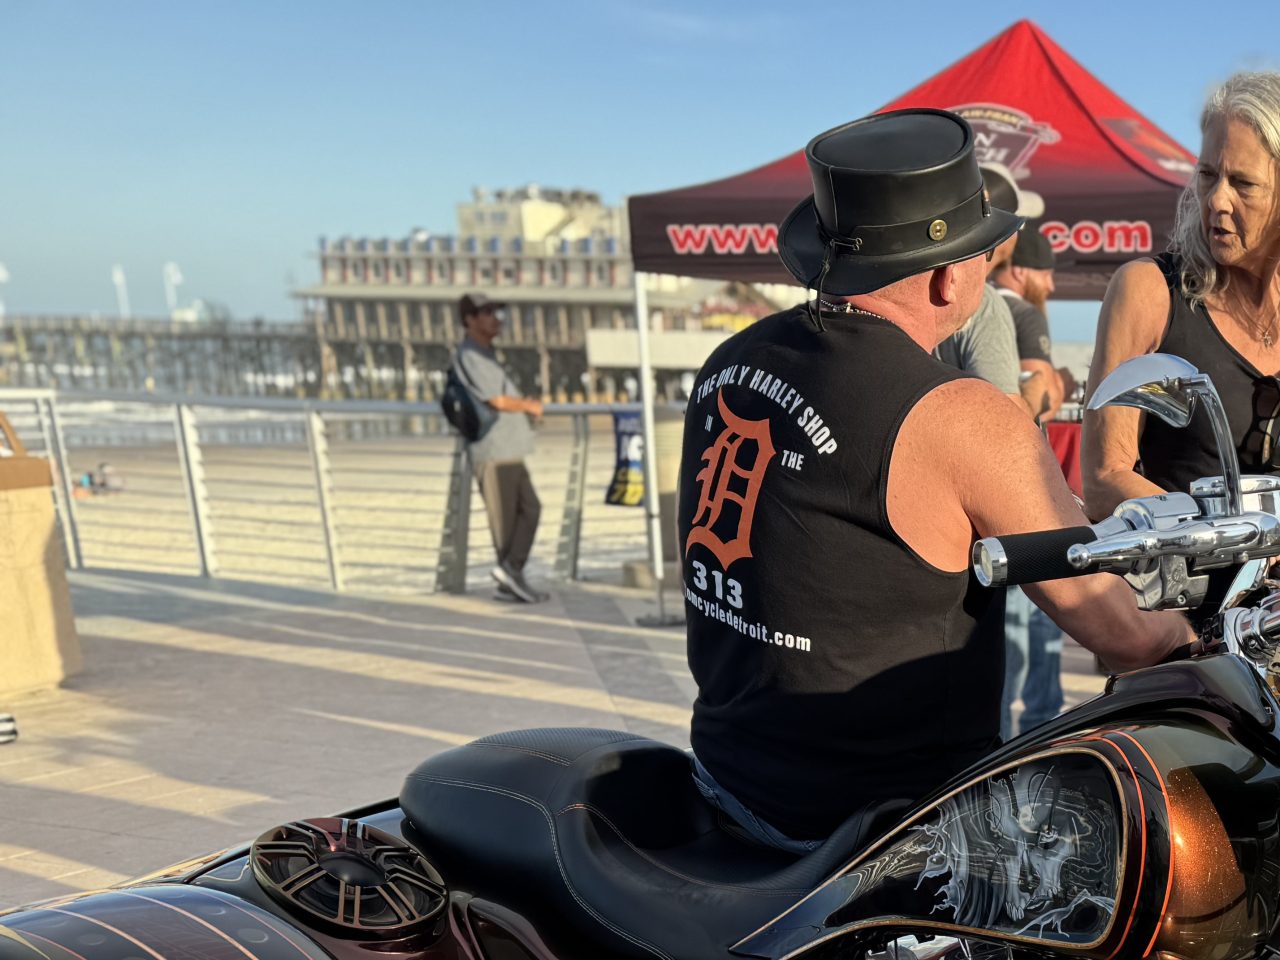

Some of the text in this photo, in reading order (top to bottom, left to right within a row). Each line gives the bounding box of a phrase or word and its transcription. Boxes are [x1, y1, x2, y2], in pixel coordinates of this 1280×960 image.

[696, 364, 838, 455] THE ONLY HARLEY SHOP
[704, 414, 805, 471] IN THE
[692, 559, 744, 609] 313
[684, 586, 812, 652] omcycledetroit.com
